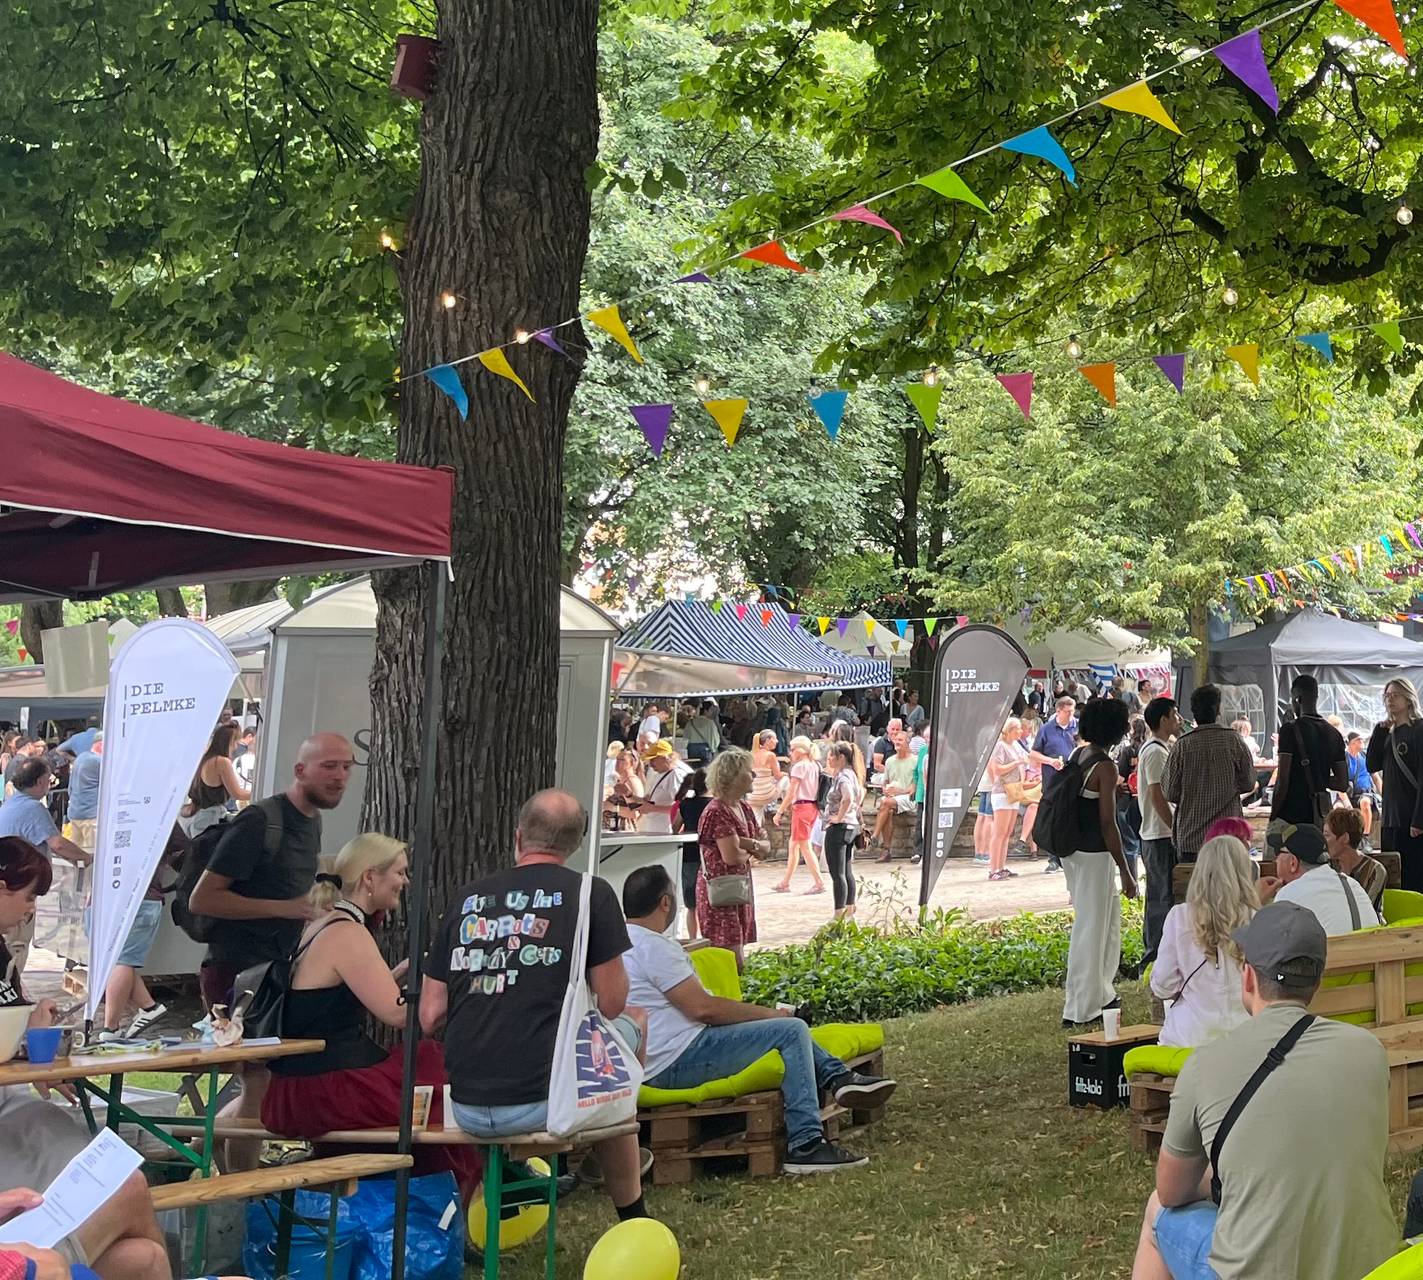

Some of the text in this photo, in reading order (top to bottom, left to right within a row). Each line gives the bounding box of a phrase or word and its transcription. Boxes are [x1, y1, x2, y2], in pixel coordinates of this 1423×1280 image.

[951, 669, 977, 680] DIE
[131, 682, 164, 697] DIE
[950, 681, 1001, 693] PELMKE
[130, 697, 196, 716] PELMKE
